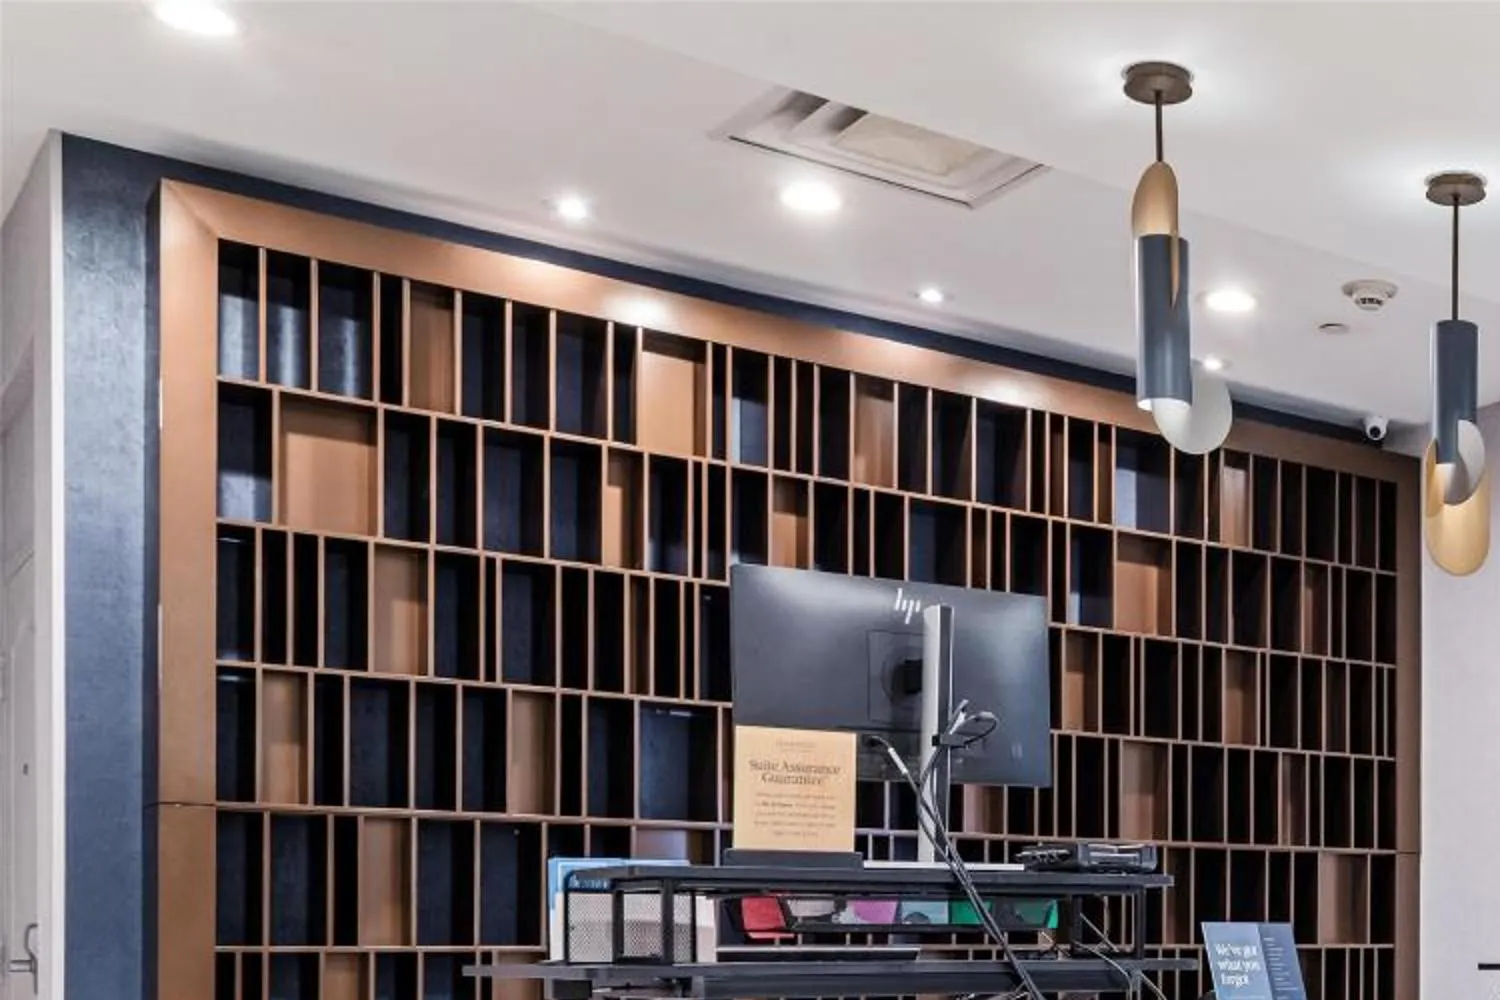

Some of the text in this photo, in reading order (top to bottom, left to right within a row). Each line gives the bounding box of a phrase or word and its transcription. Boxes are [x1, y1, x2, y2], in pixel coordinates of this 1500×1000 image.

[894, 587, 921, 625] hp
[782, 761, 841, 775] Assurance
[1217, 958, 1243, 971] what
